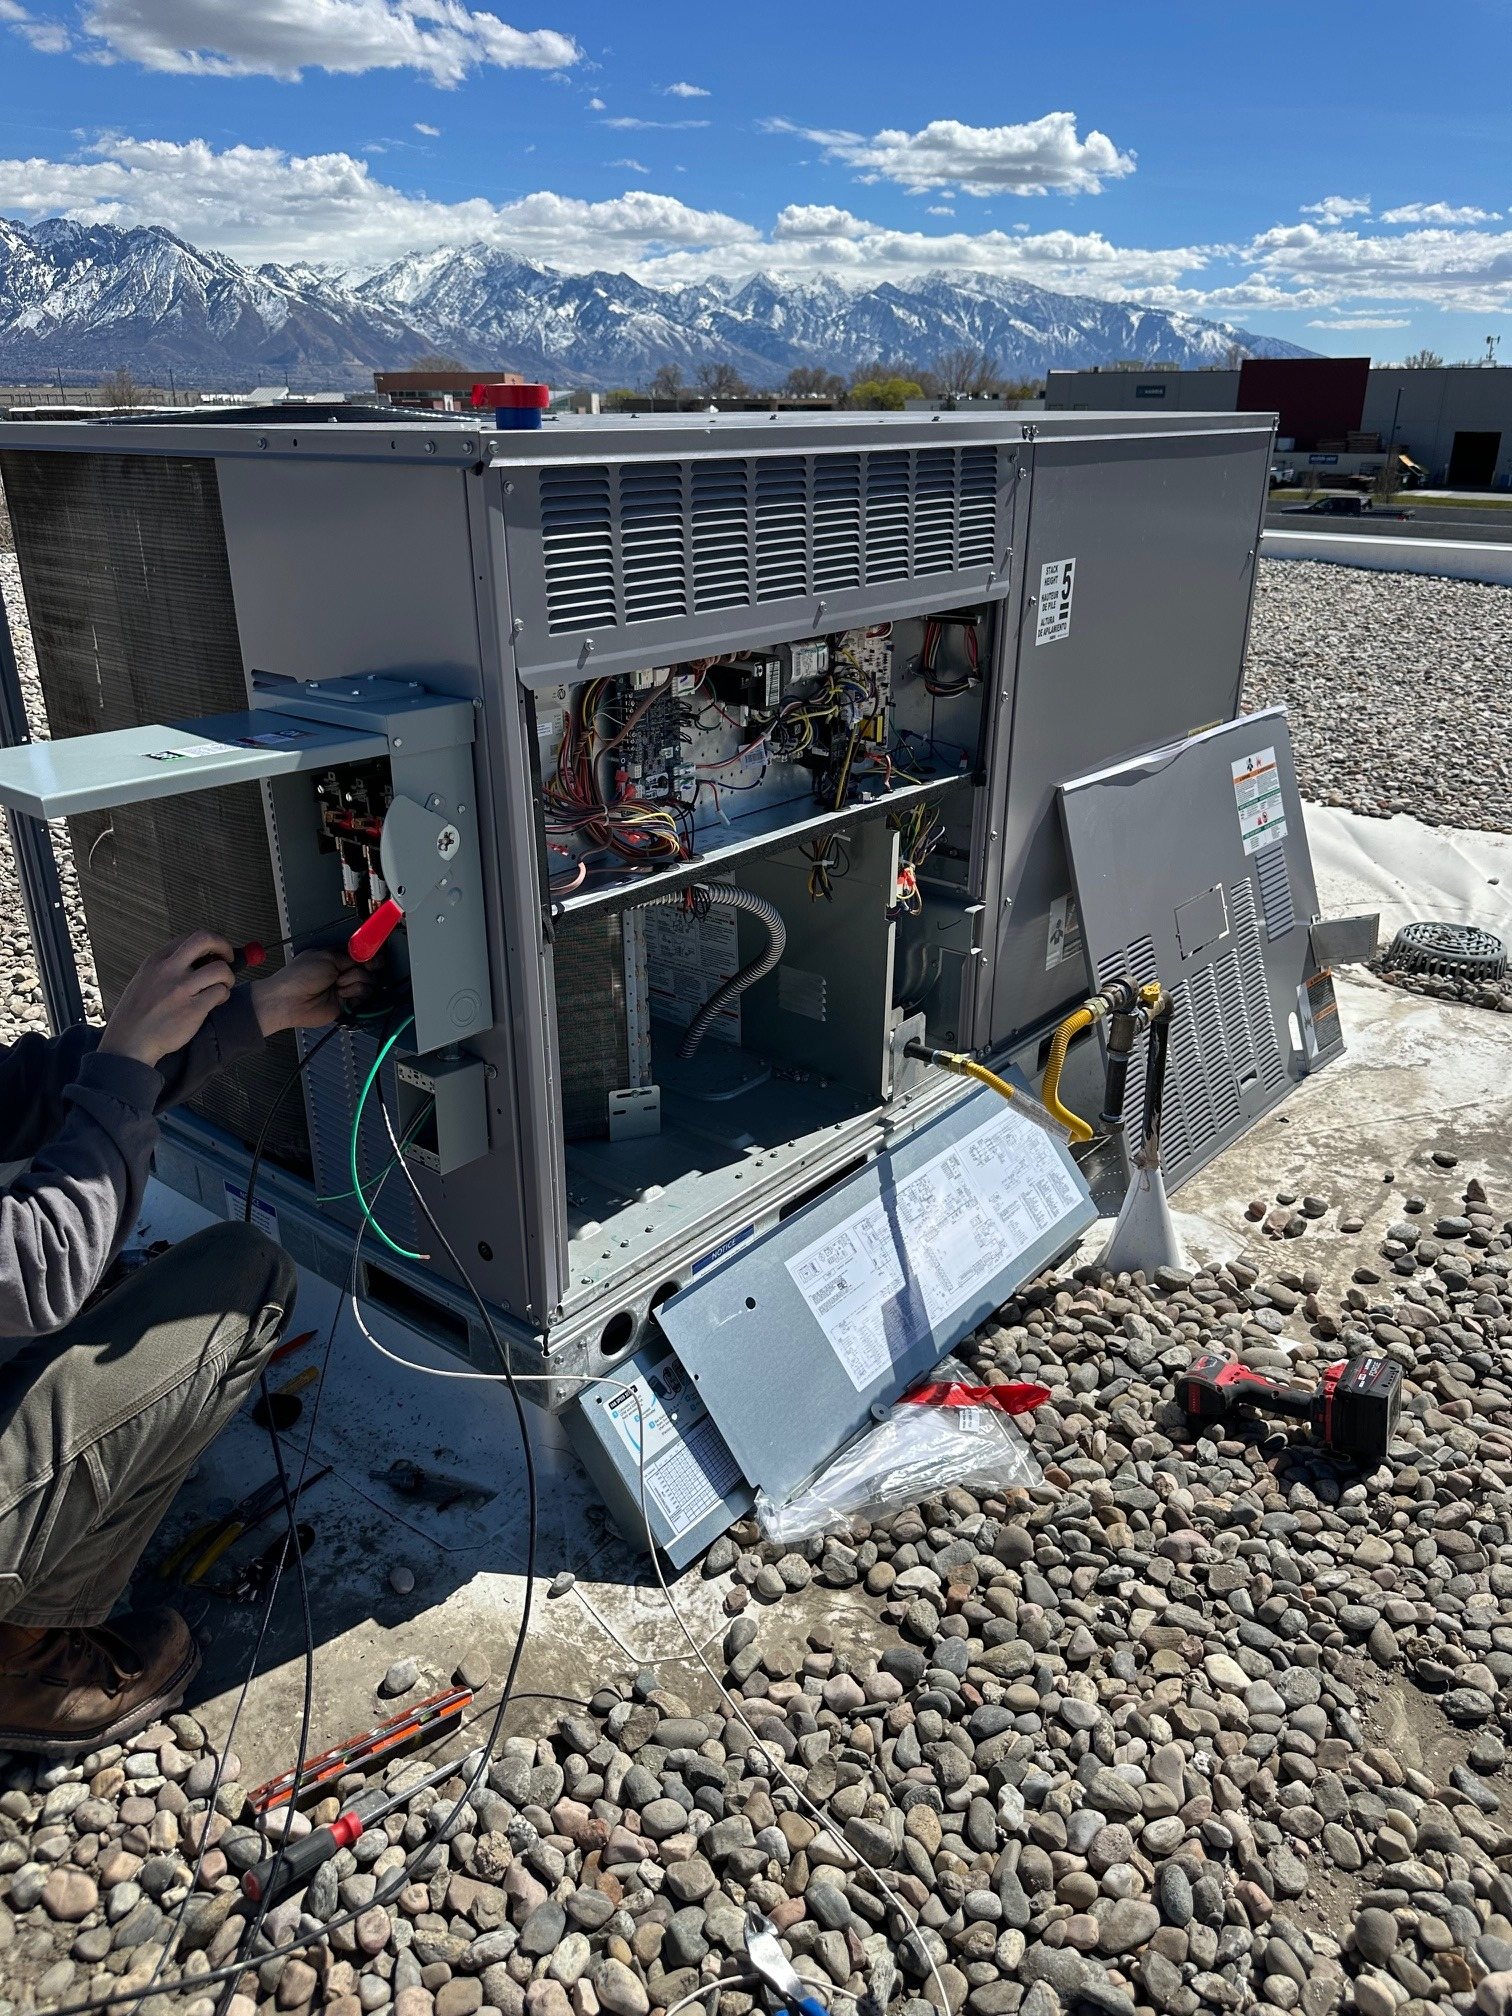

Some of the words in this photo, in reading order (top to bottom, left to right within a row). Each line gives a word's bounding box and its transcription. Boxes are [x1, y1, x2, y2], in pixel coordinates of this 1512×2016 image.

[1046, 565, 1059, 575] STACK
[1044, 575, 1059, 586] HEIGHT
[1061, 562, 1073, 600] 5
[1041, 590, 1059, 601] HAUTEUR
[1047, 601, 1057, 610] PILE
[711, 1238, 737, 1261] NOTICE
